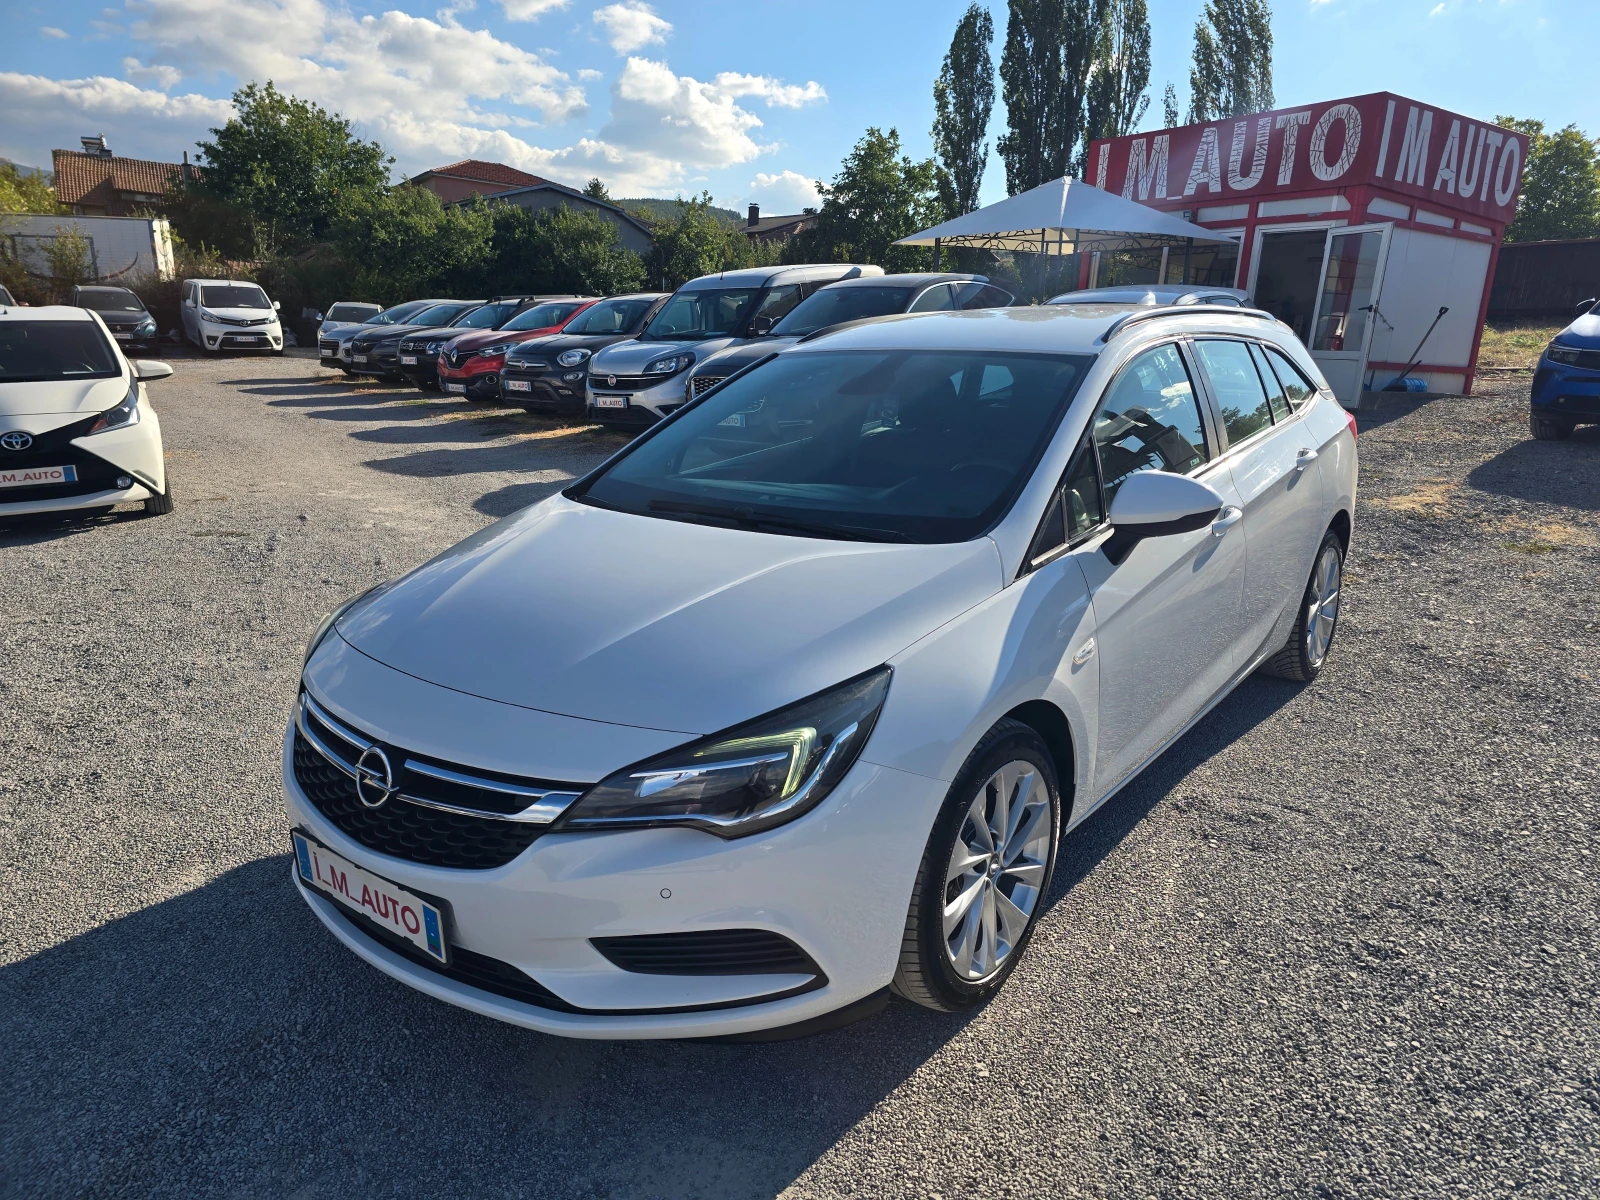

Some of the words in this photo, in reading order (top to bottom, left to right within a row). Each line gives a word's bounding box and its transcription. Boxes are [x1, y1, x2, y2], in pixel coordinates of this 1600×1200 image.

[1375, 99, 1396, 178] I
[1394, 105, 1434, 187] M
[1433, 119, 1521, 207] AUTO
